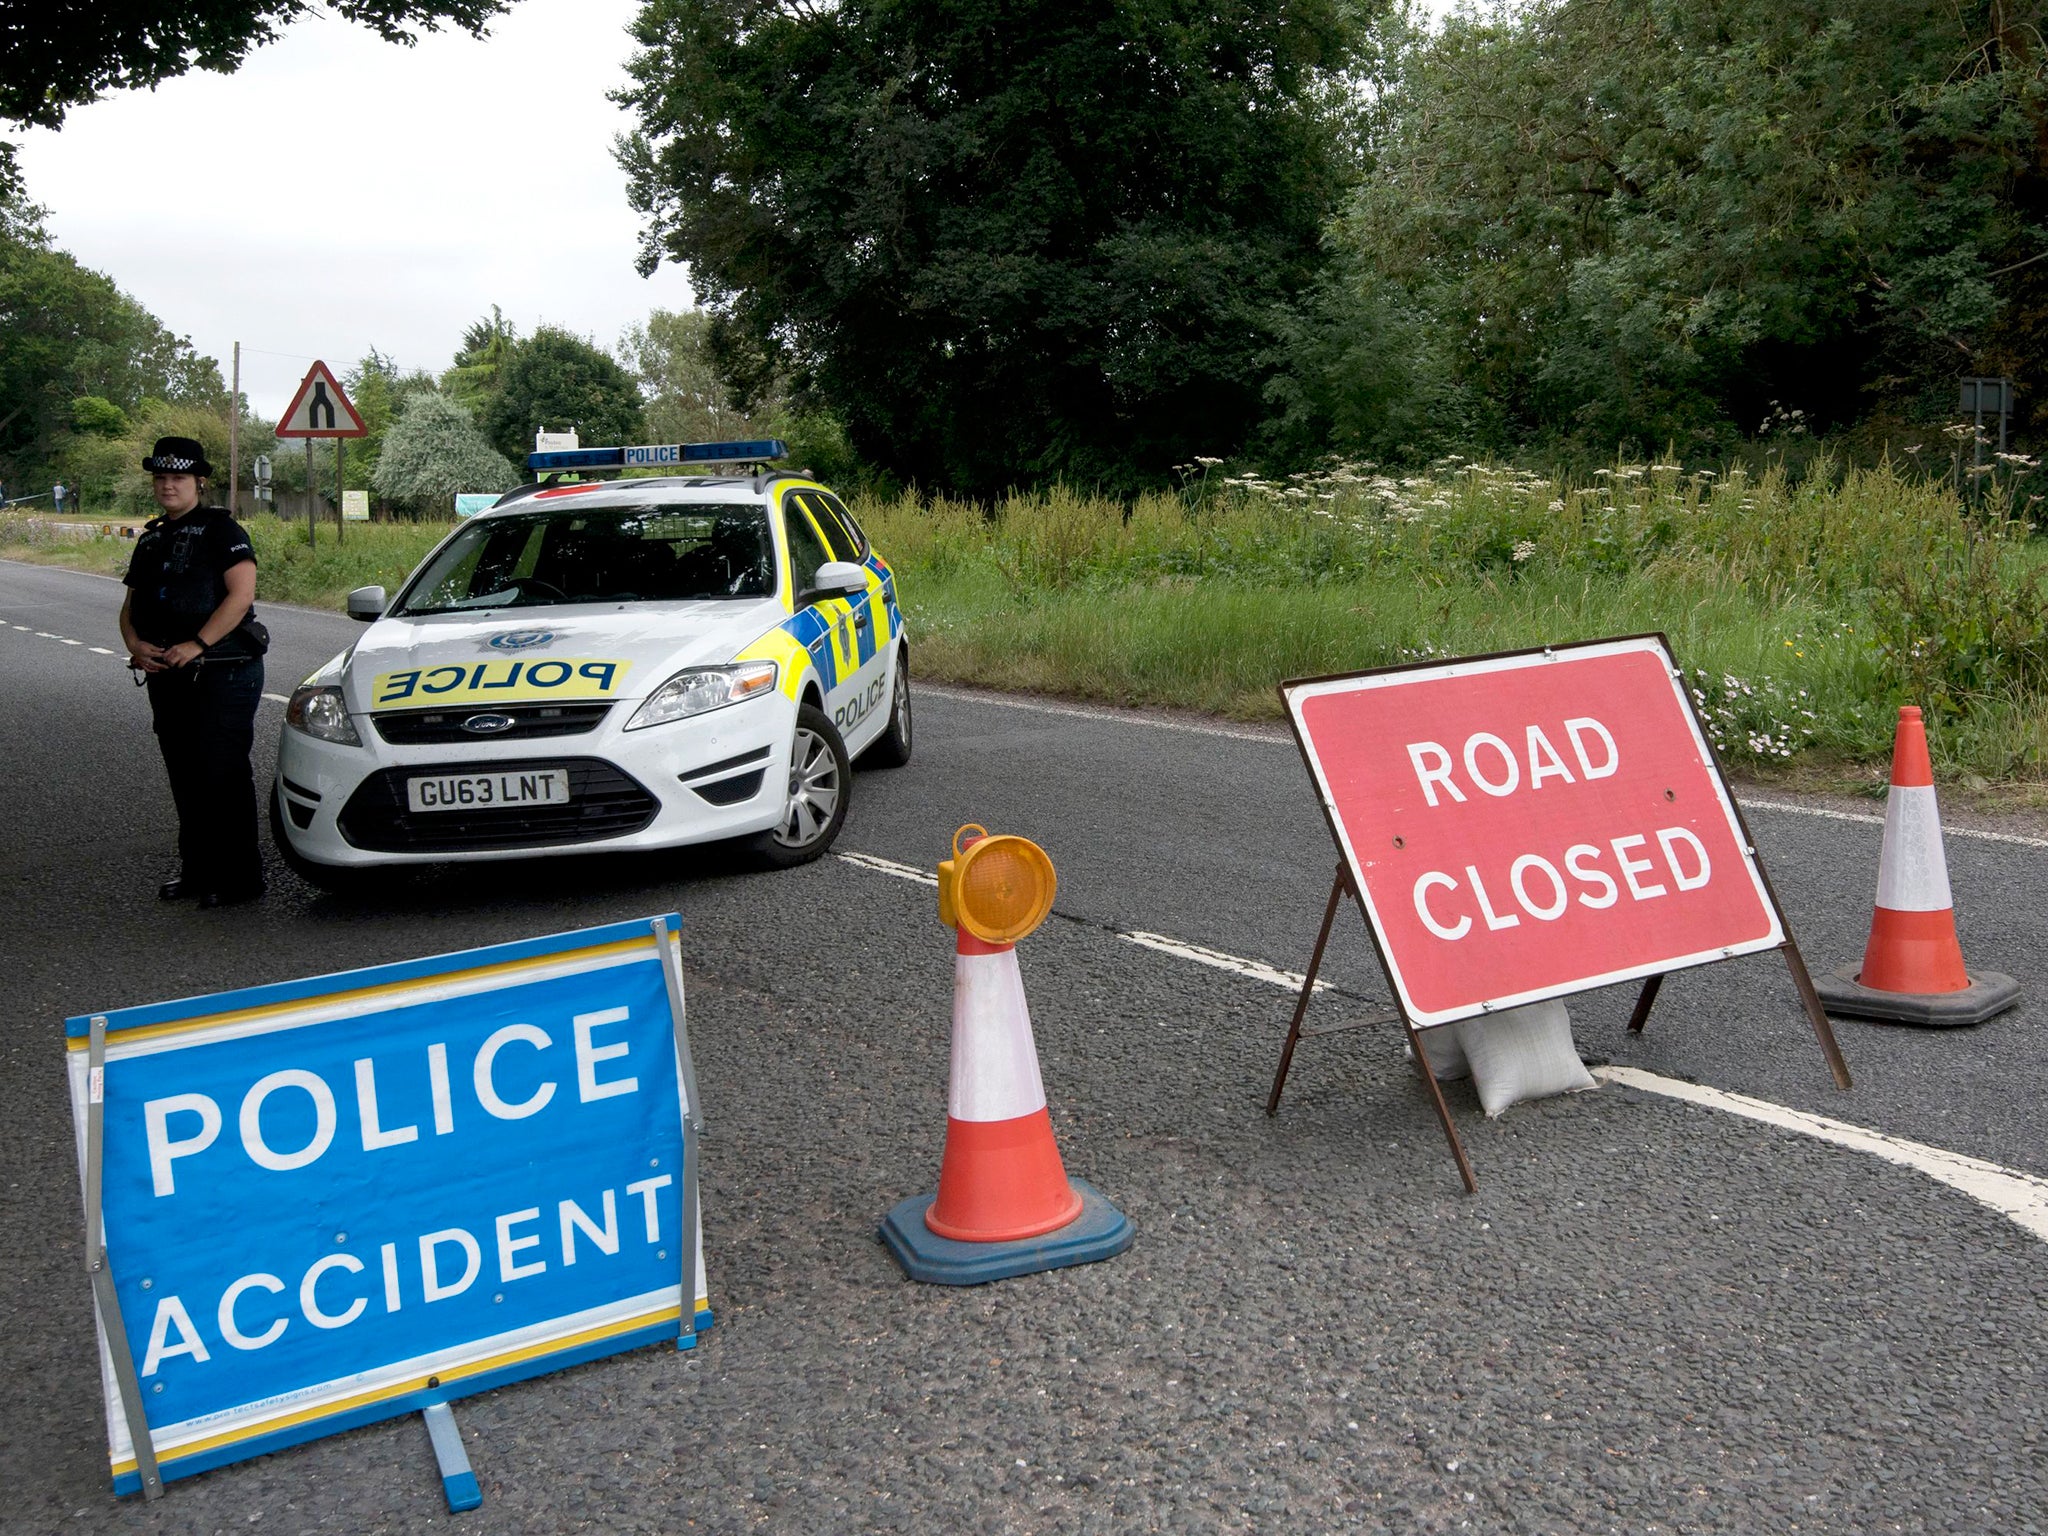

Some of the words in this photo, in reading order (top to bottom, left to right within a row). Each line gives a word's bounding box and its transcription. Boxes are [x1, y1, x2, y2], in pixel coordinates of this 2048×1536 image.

[626, 446, 679, 463] POLICE
[835, 671, 886, 728] POLICE
[420, 778, 492, 806] GU63
[503, 774, 555, 801] LNT
[1406, 716, 1621, 807] ROAD
[1413, 826, 1713, 941] CLOSED
[143, 1006, 640, 1198] POLICE
[142, 1175, 673, 1377] ACCIDENT
